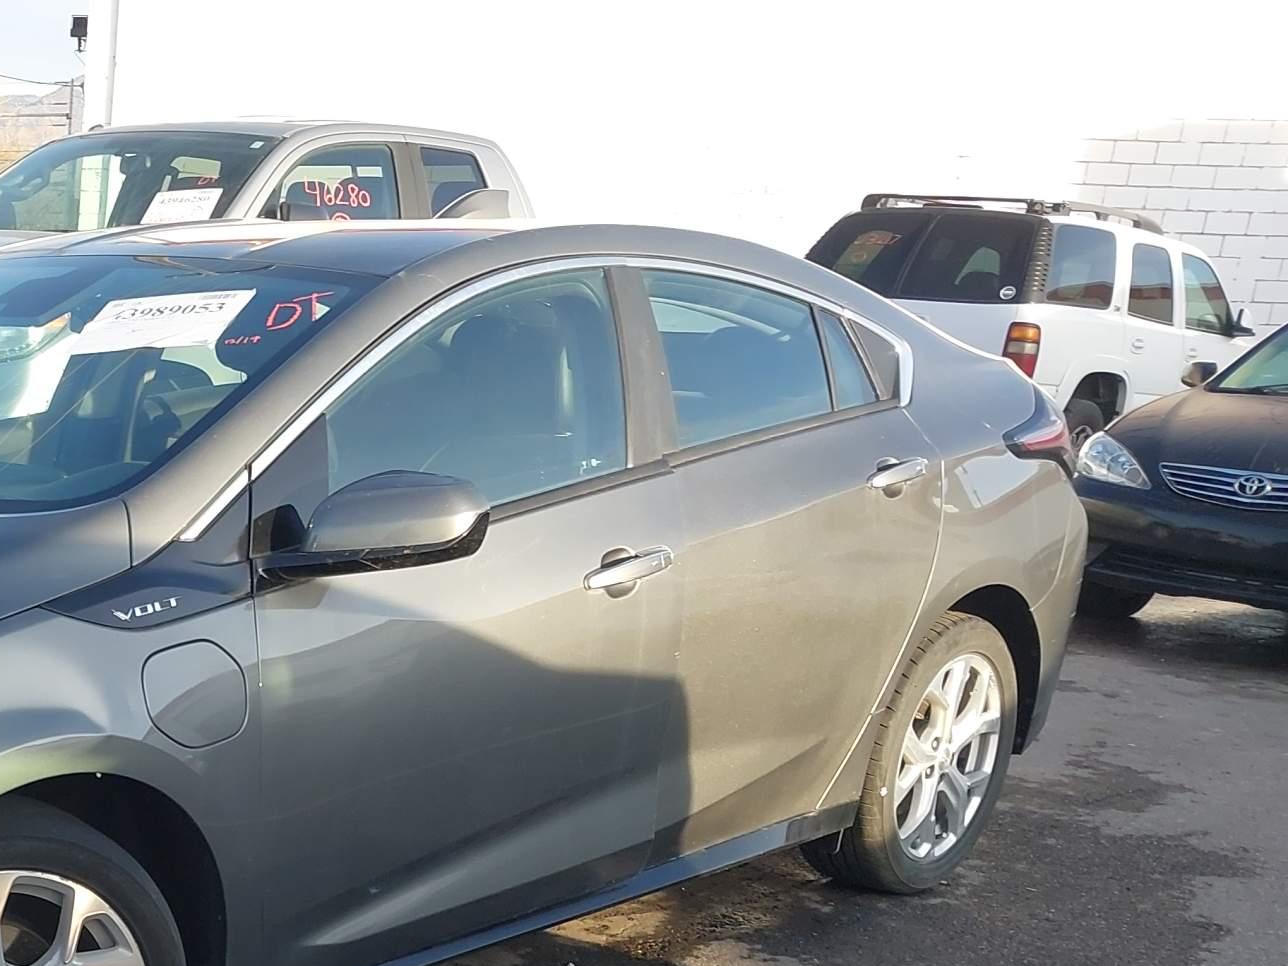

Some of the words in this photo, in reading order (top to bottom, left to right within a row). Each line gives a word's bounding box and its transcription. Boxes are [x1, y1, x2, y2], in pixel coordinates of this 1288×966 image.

[304, 176, 370, 207] 46280
[266, 292, 334, 331] DT
[112, 596, 182, 621] VOLT
